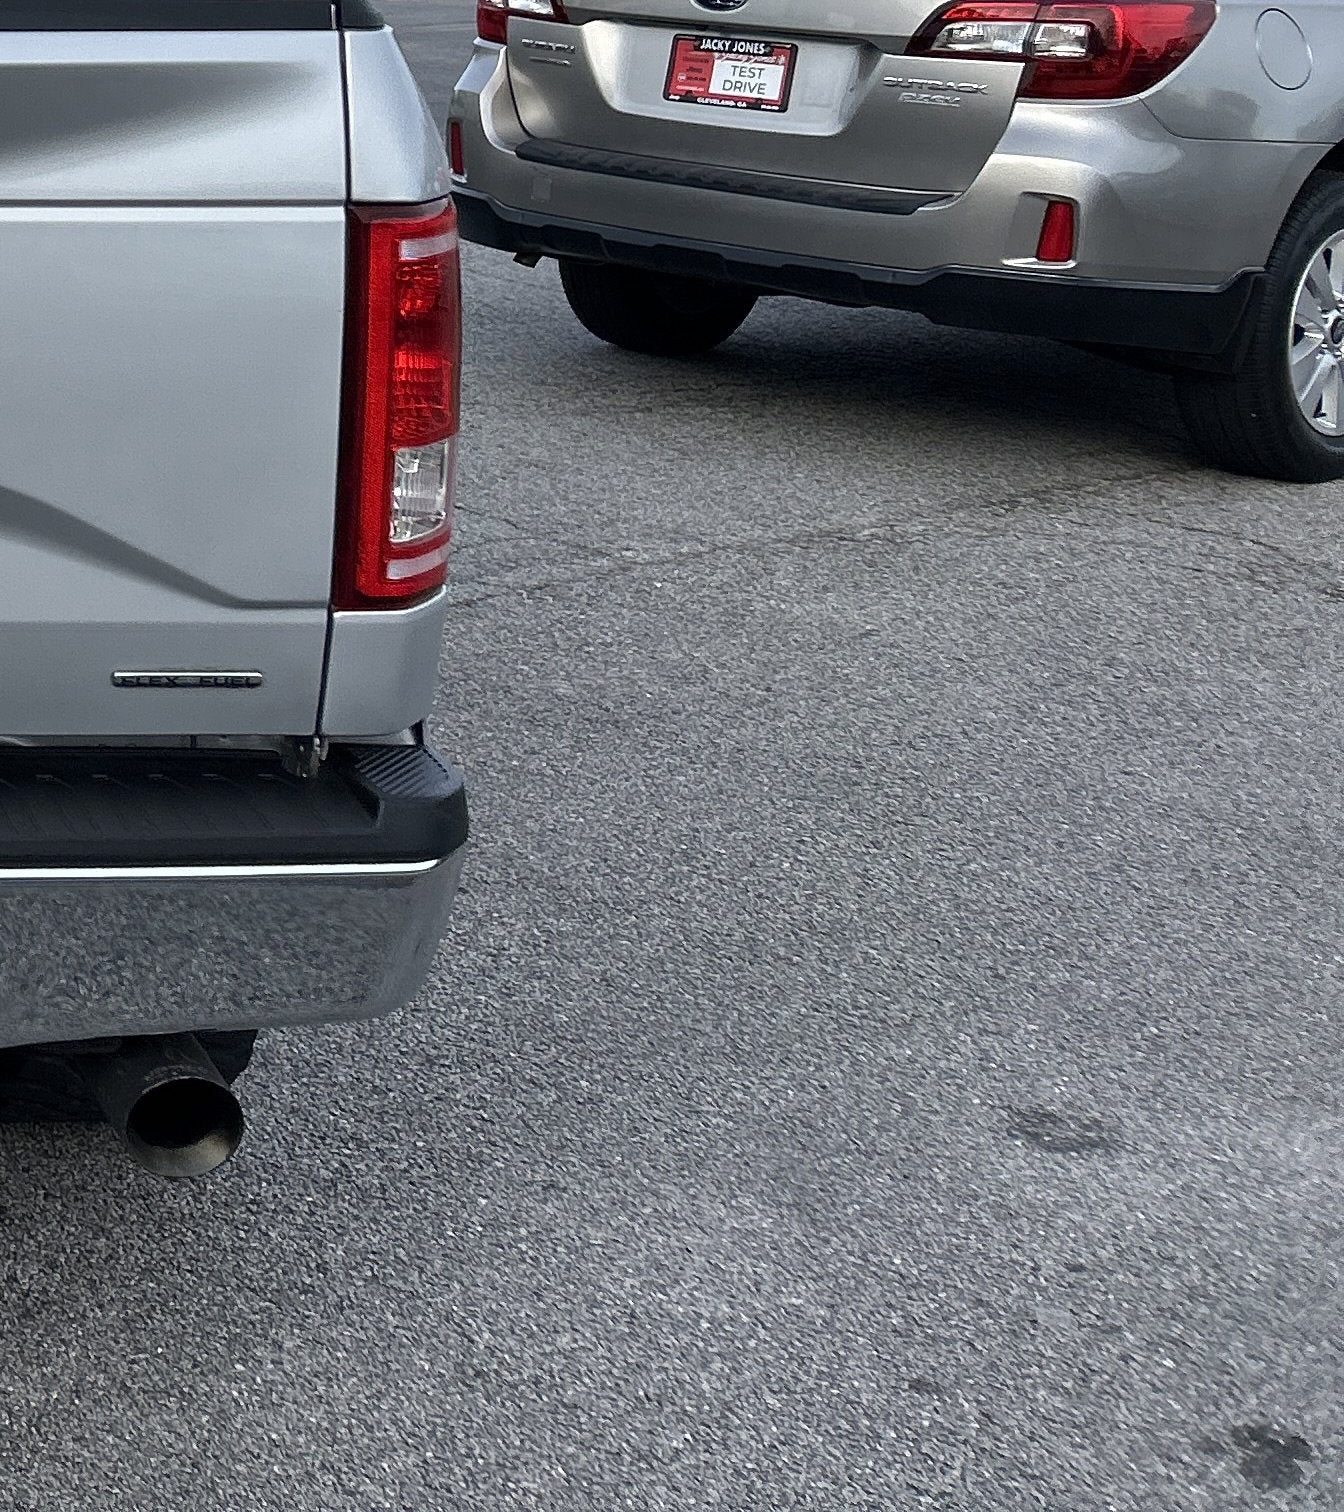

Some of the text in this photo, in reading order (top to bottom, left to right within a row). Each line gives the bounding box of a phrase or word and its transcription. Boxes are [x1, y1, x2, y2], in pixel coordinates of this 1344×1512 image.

[700, 38, 765, 55] JACKY JONES
[731, 65, 765, 79] TEST
[722, 79, 767, 95] DRIVE
